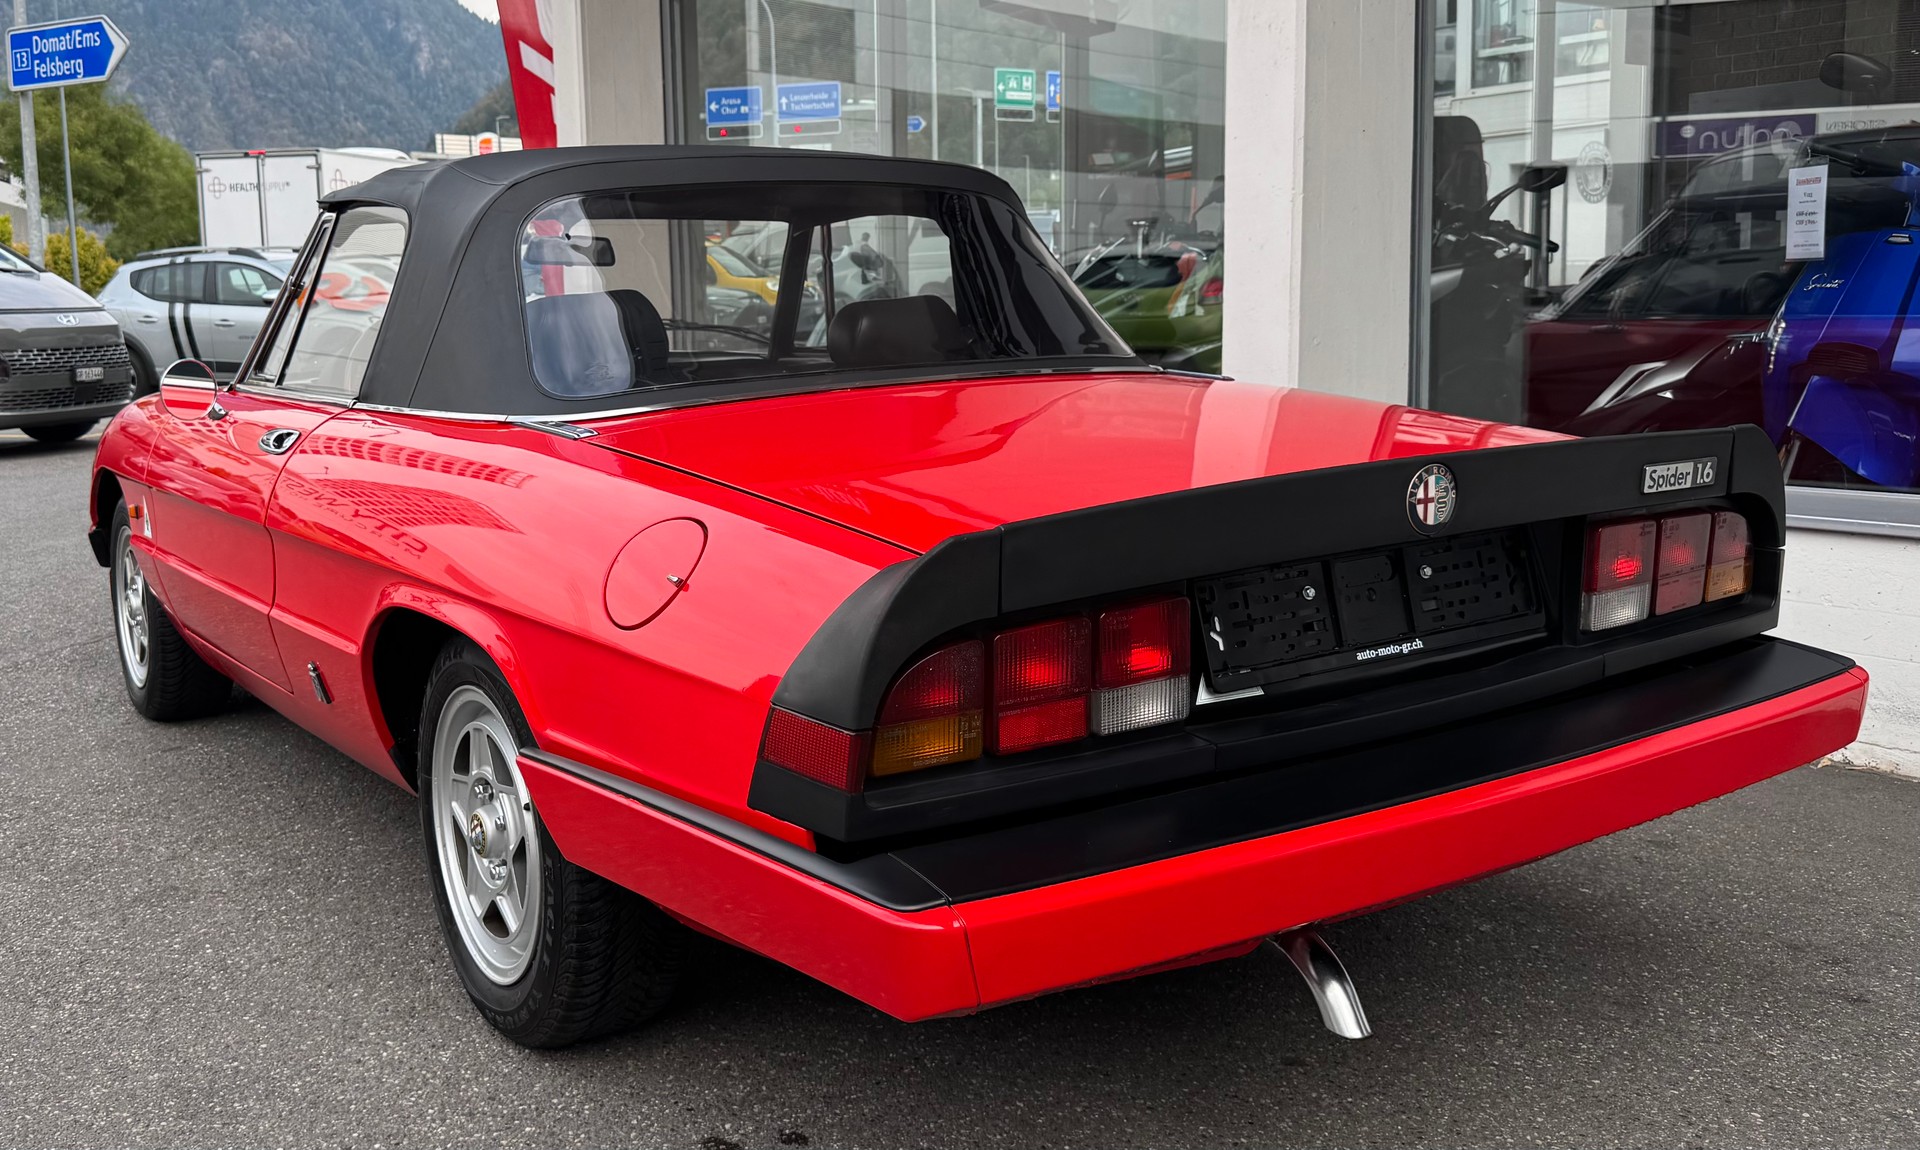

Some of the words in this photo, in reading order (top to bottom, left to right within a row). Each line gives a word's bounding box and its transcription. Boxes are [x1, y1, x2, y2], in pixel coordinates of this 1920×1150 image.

[32, 29, 101, 55] Domat/Ems
[16, 52, 28, 68] 13
[34, 56, 84, 79] Felsberg
[721, 106, 738, 115] Chur
[1408, 471, 1429, 504] ALFA
[1647, 466, 1691, 491] Spider
[1696, 461, 1714, 484] 1.6
[1355, 638, 1424, 661] auto-moto-gr.ch
